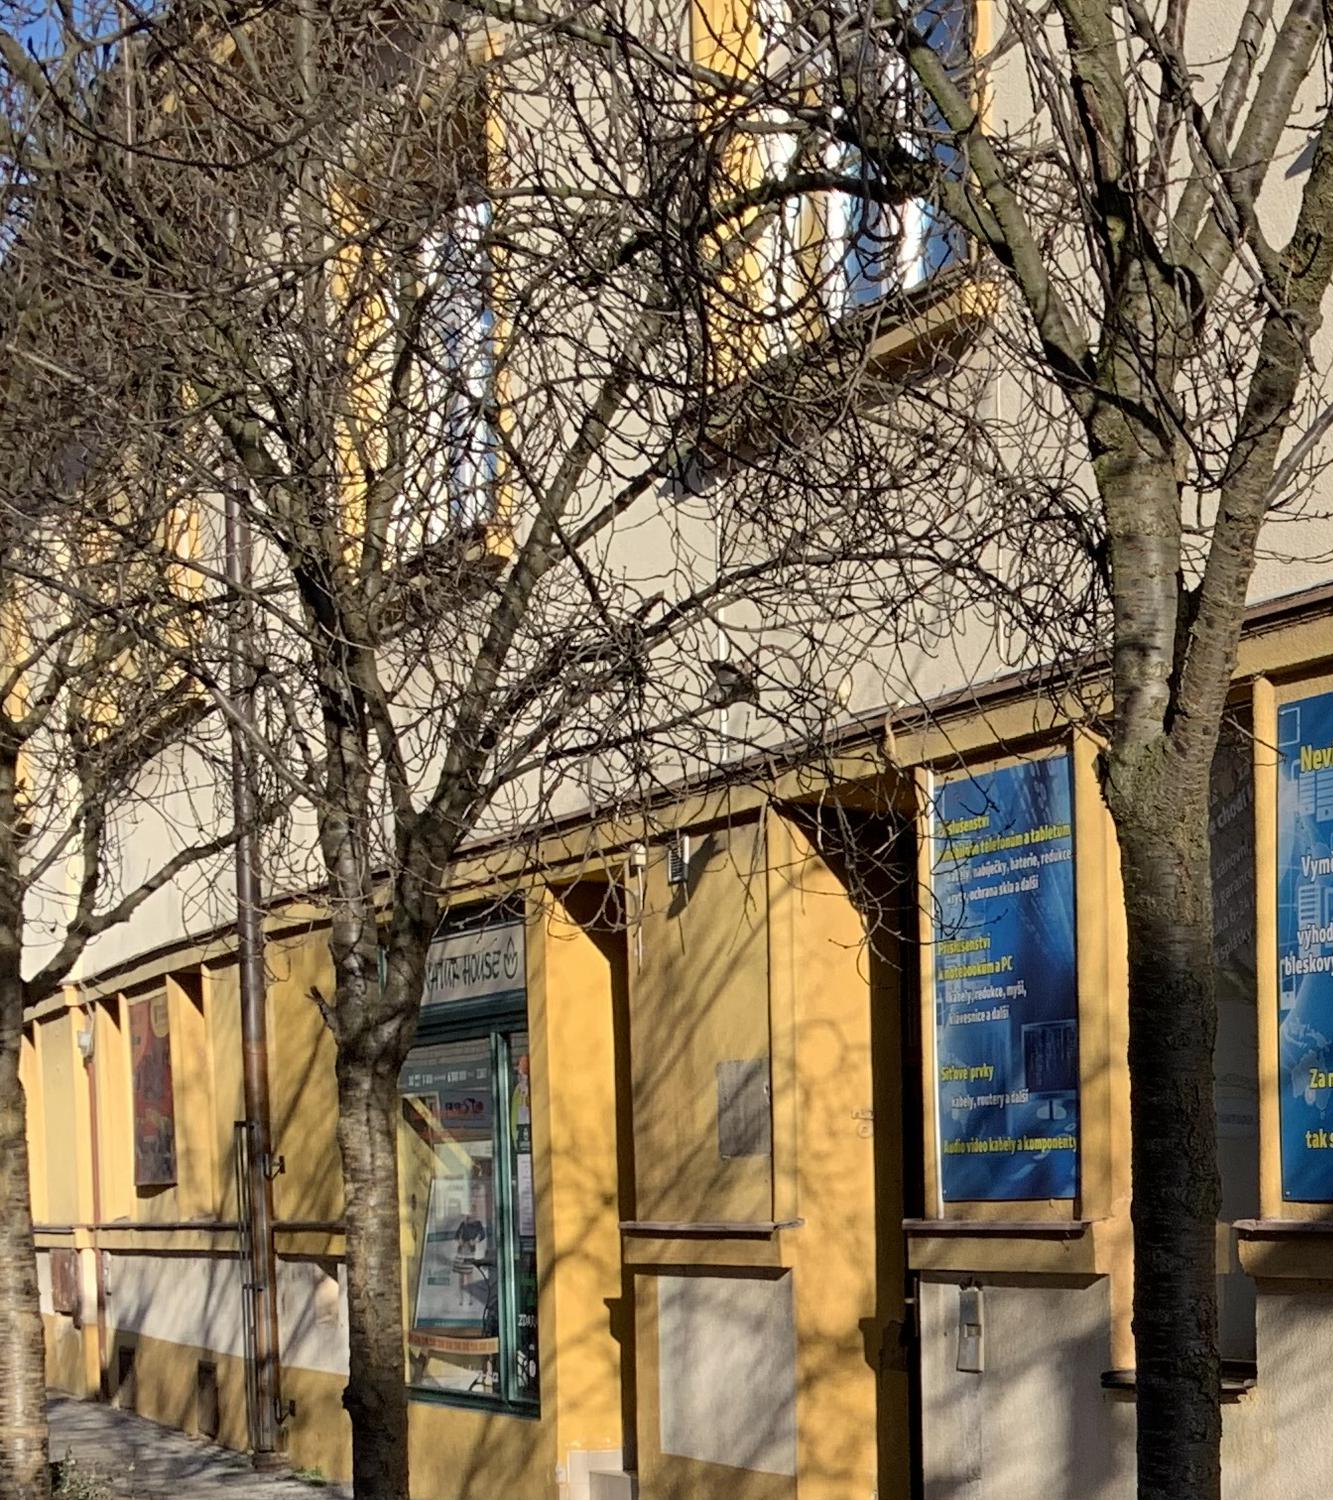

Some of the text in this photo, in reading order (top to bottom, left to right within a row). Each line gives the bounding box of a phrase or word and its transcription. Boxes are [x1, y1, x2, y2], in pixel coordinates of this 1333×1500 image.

[1002, 955, 1014, 972] PC
[1309, 1068, 1325, 1089] Za
[1305, 1129, 1327, 1148] tak
